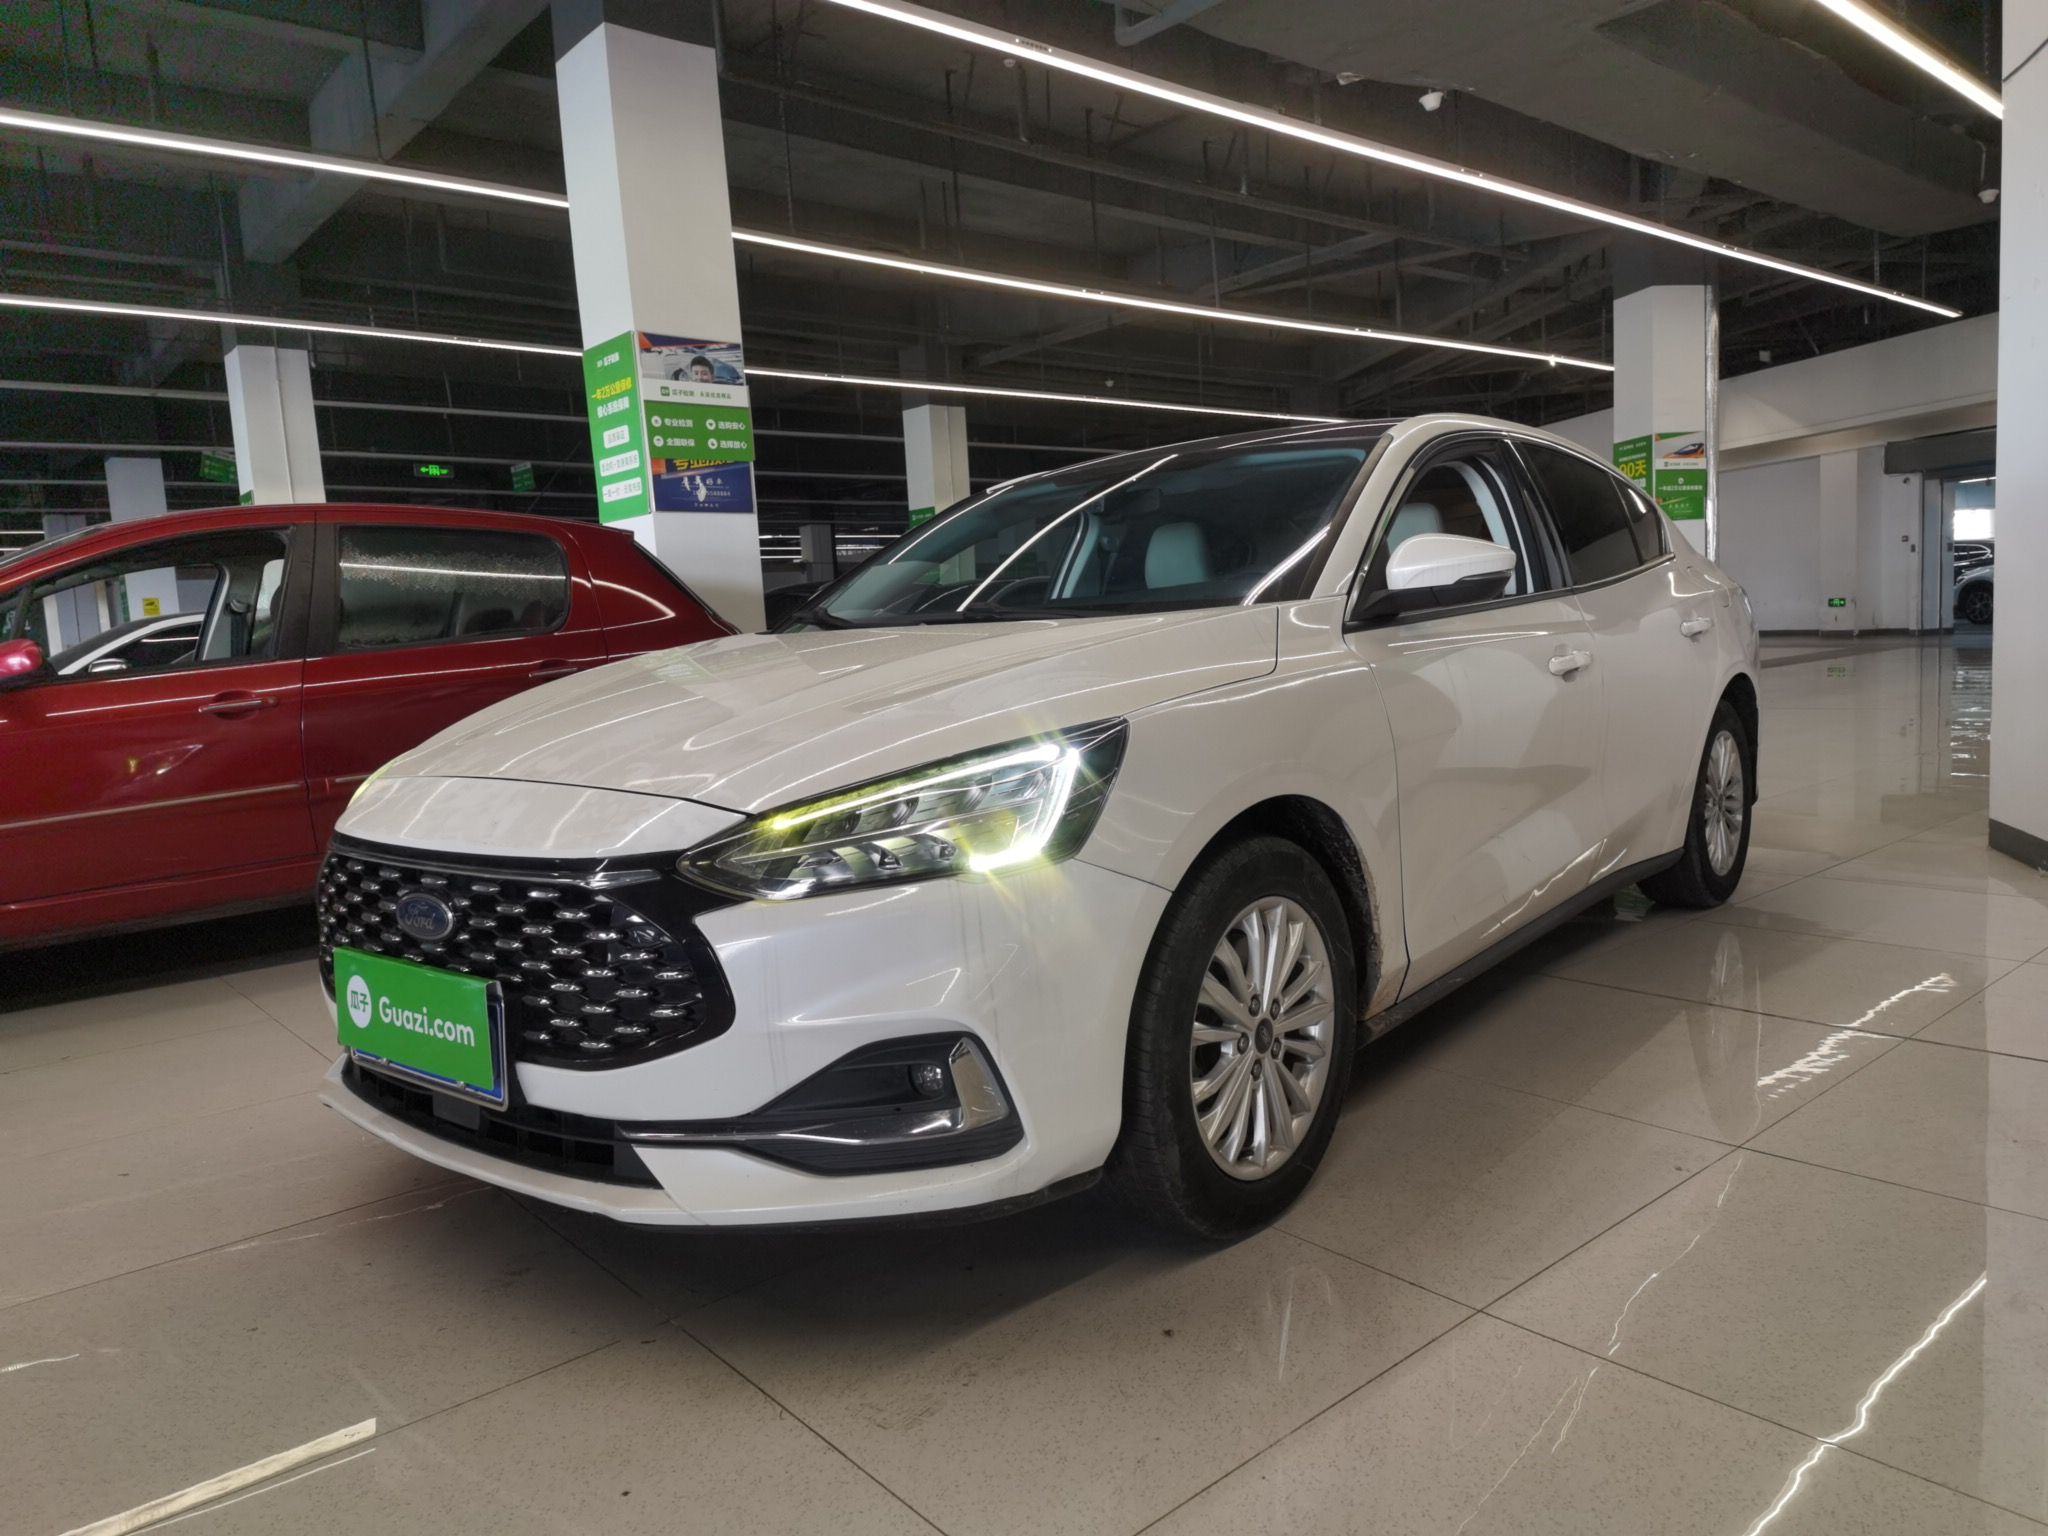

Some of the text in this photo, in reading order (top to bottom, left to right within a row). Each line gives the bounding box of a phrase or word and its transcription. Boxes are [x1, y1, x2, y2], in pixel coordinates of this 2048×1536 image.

[405, 903, 436, 930] Ford
[351, 991, 475, 1047] 瓜子 Guazi.com
